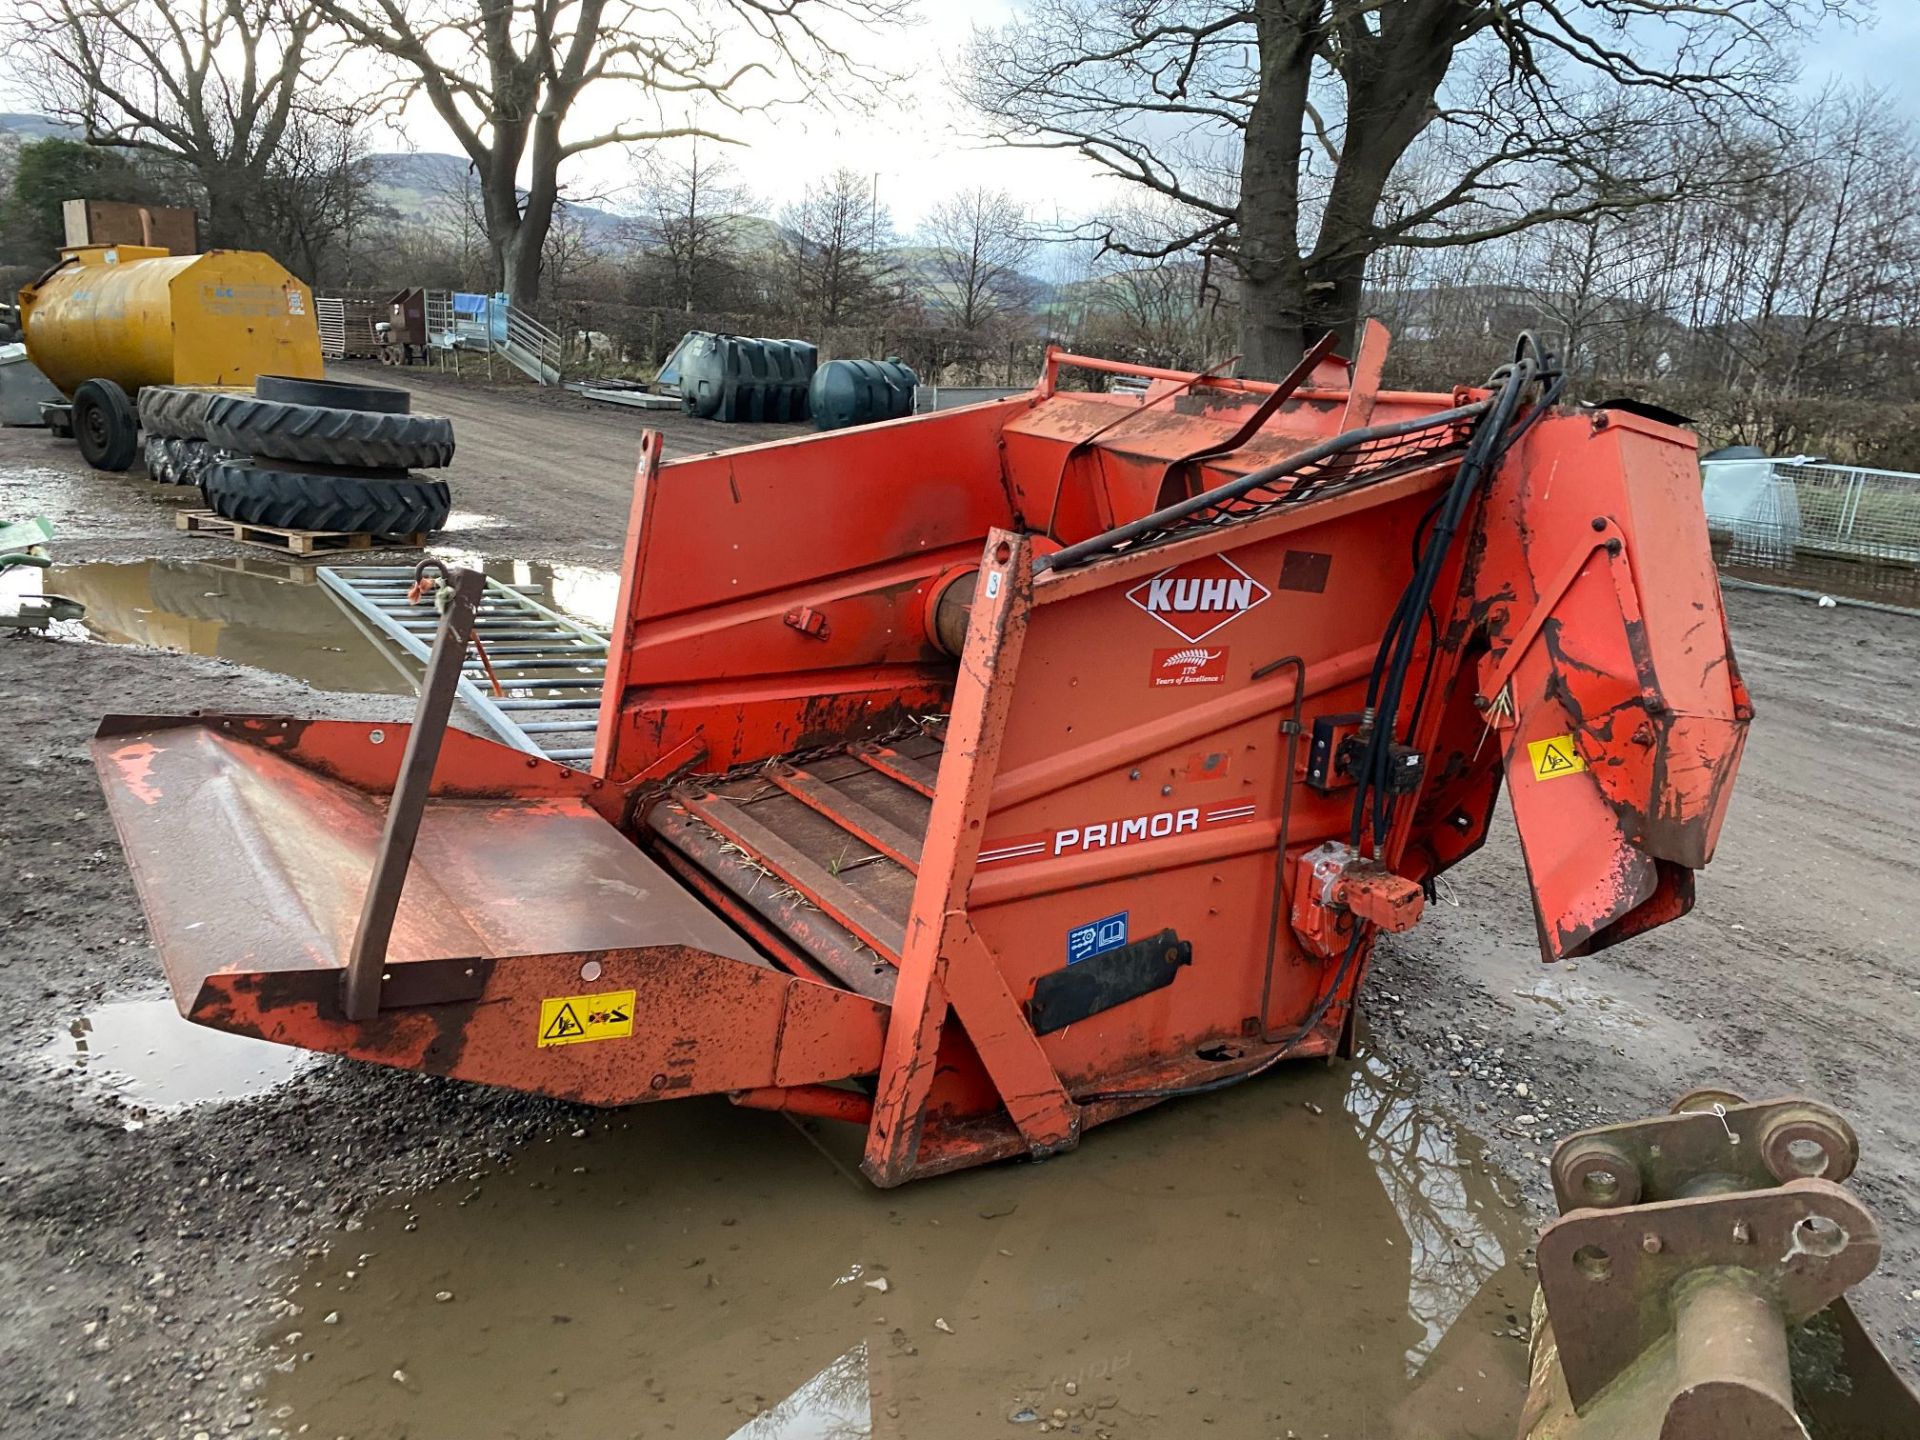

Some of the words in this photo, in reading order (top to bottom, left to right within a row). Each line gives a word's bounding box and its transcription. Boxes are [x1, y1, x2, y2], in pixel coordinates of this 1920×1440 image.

[1147, 579, 1253, 611] KUHN
[1175, 676, 1184, 685] of
[1184, 675, 1219, 683] Excellence
[1181, 667, 1197, 675] 175
[1054, 808, 1200, 855] PRIMOR
